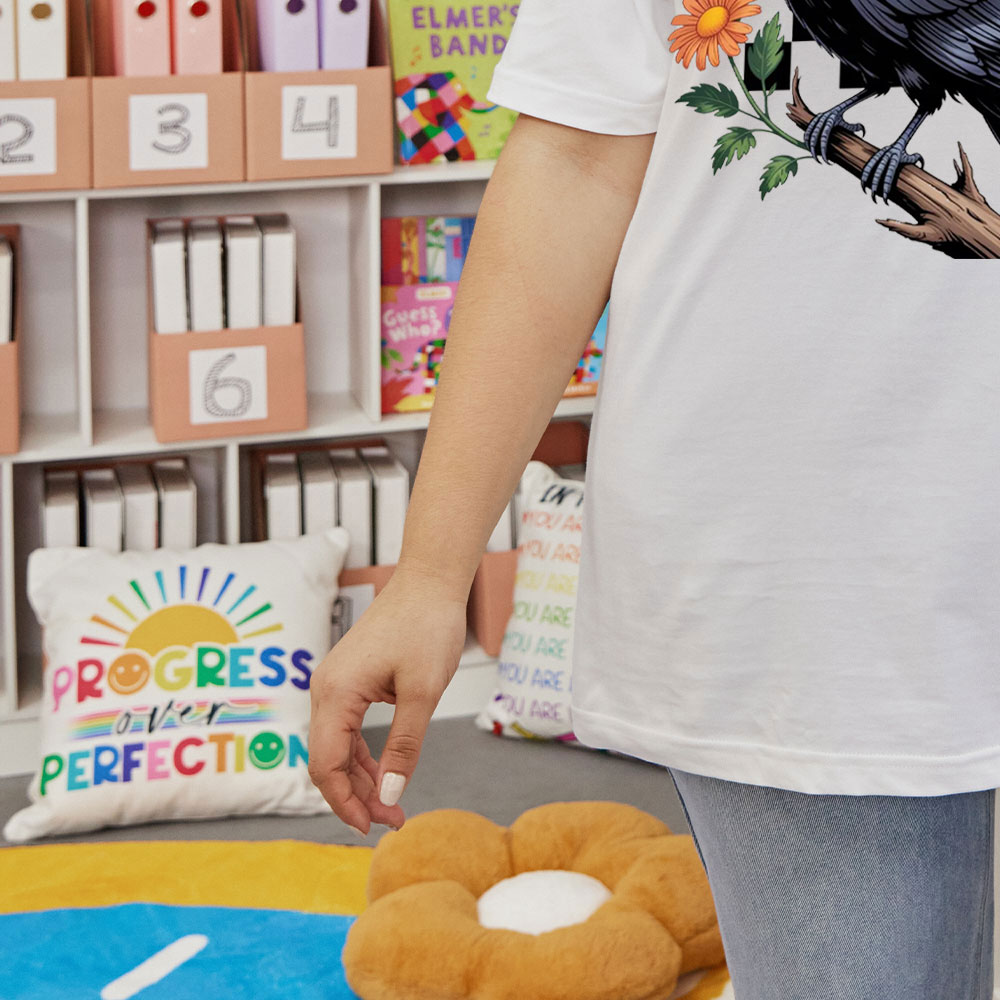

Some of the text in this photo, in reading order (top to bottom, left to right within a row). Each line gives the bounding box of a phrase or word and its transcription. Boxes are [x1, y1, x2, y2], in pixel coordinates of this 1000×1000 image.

[412, 4, 519, 29] ELMER'S
[430, 33, 507, 59] BAND
[0, 114, 34, 163] 2
[152, 103, 193, 154] 3
[290, 96, 338, 148] 4
[382, 305, 438, 328] Guess
[388, 319, 443, 343] Who?
[203, 353, 253, 418] 6
[52, 646, 314, 713] PROGRESS
[531, 668, 564, 691] ARE
[116, 699, 230, 736] over
[40, 731, 310, 796] PERFECTION
